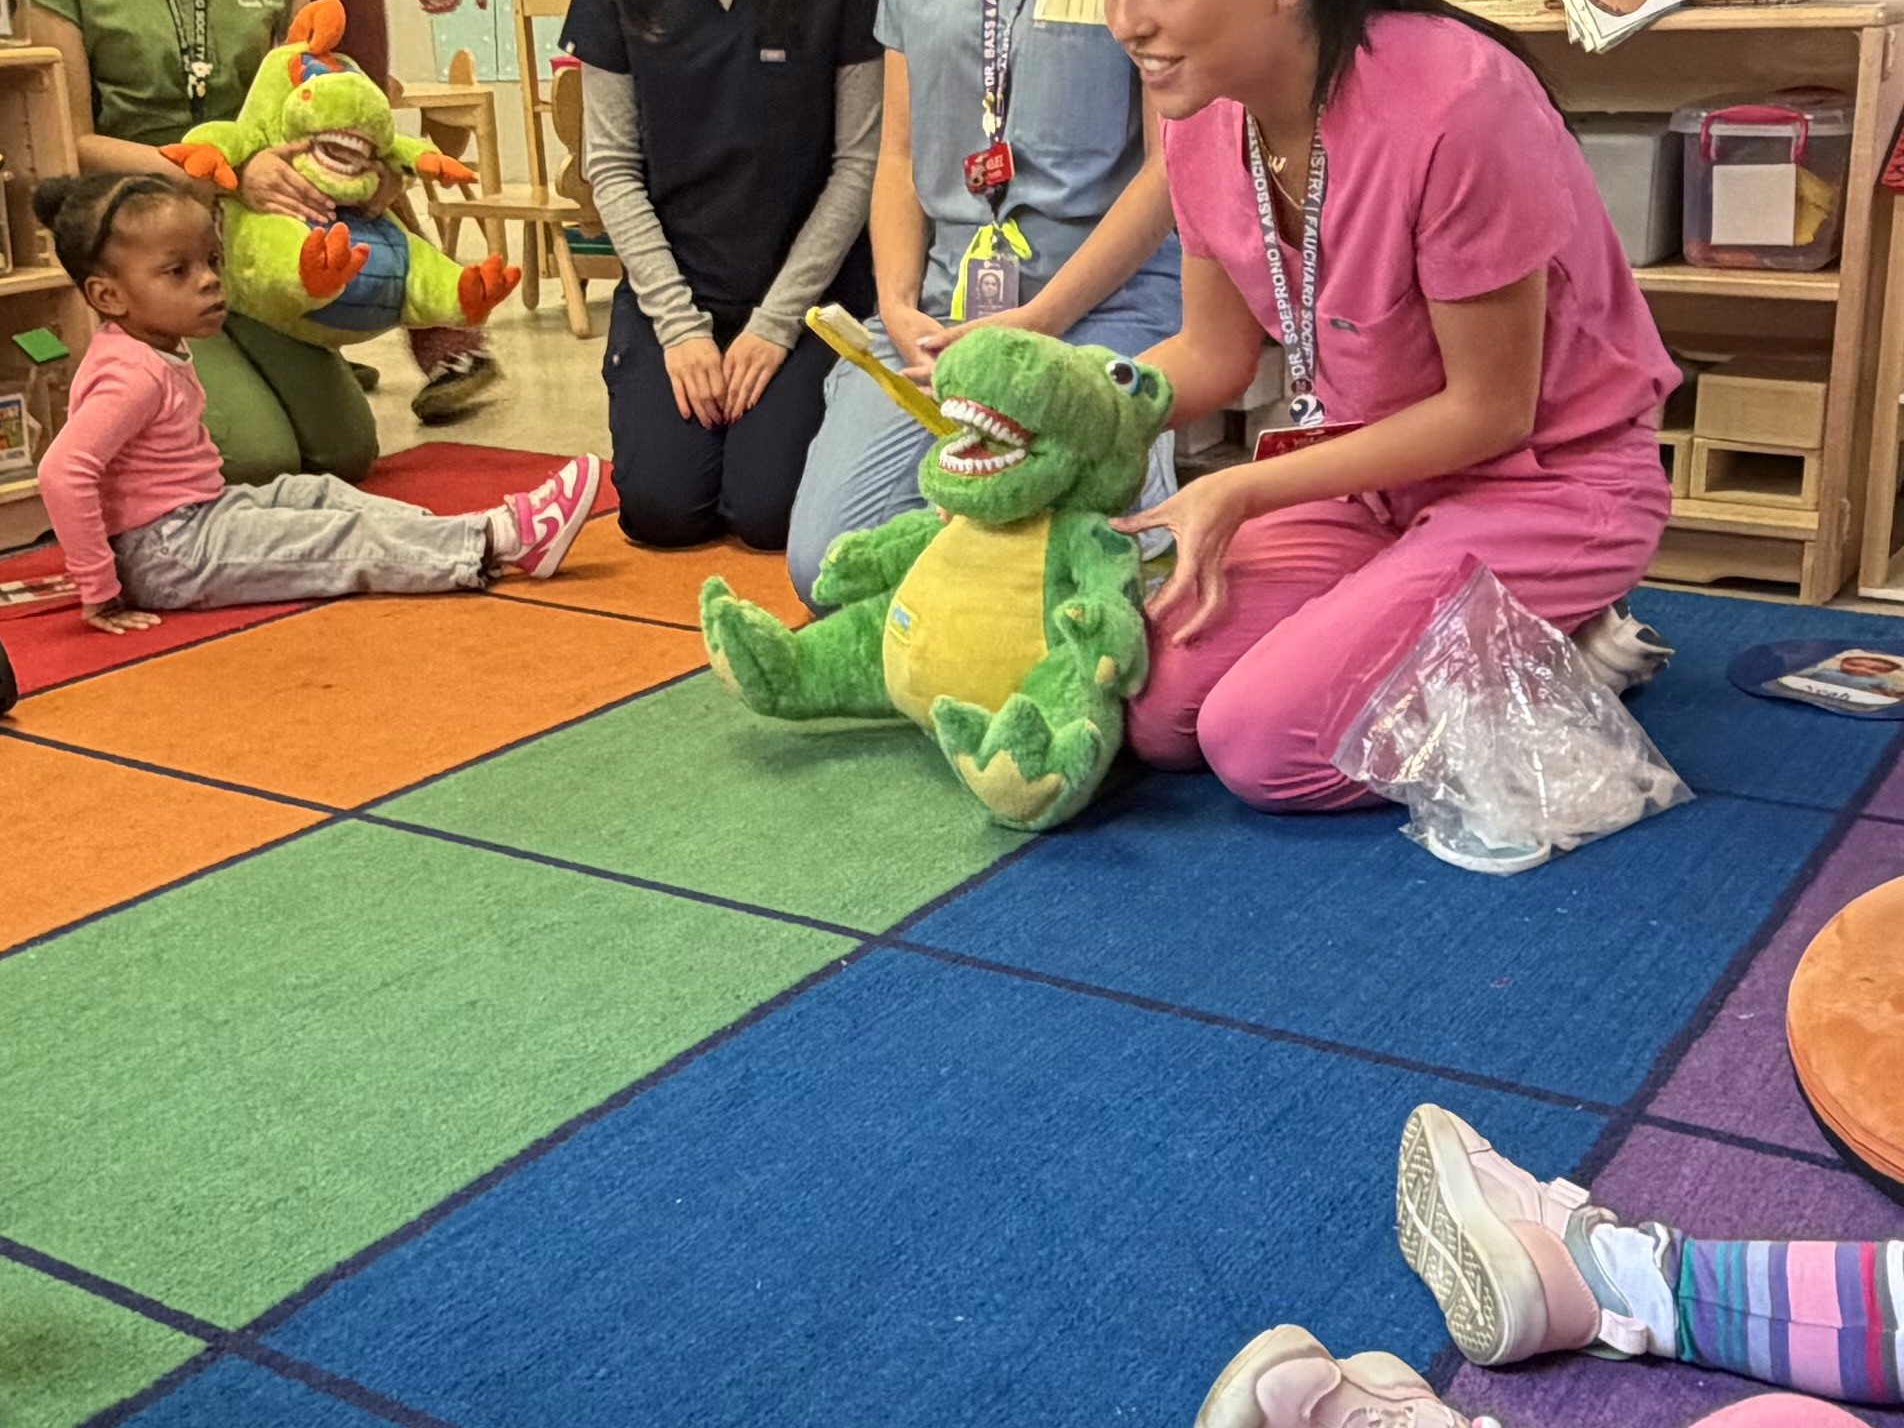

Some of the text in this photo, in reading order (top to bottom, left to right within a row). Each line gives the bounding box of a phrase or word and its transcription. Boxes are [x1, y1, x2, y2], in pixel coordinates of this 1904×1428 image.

[983, 22, 996, 59] BASS
[983, 60, 995, 87] DR.
[1301, 214, 1318, 306] FAUCHARD
[1266, 249, 1297, 344] SOEPRONO
[1299, 309, 1314, 371] SOCIET
